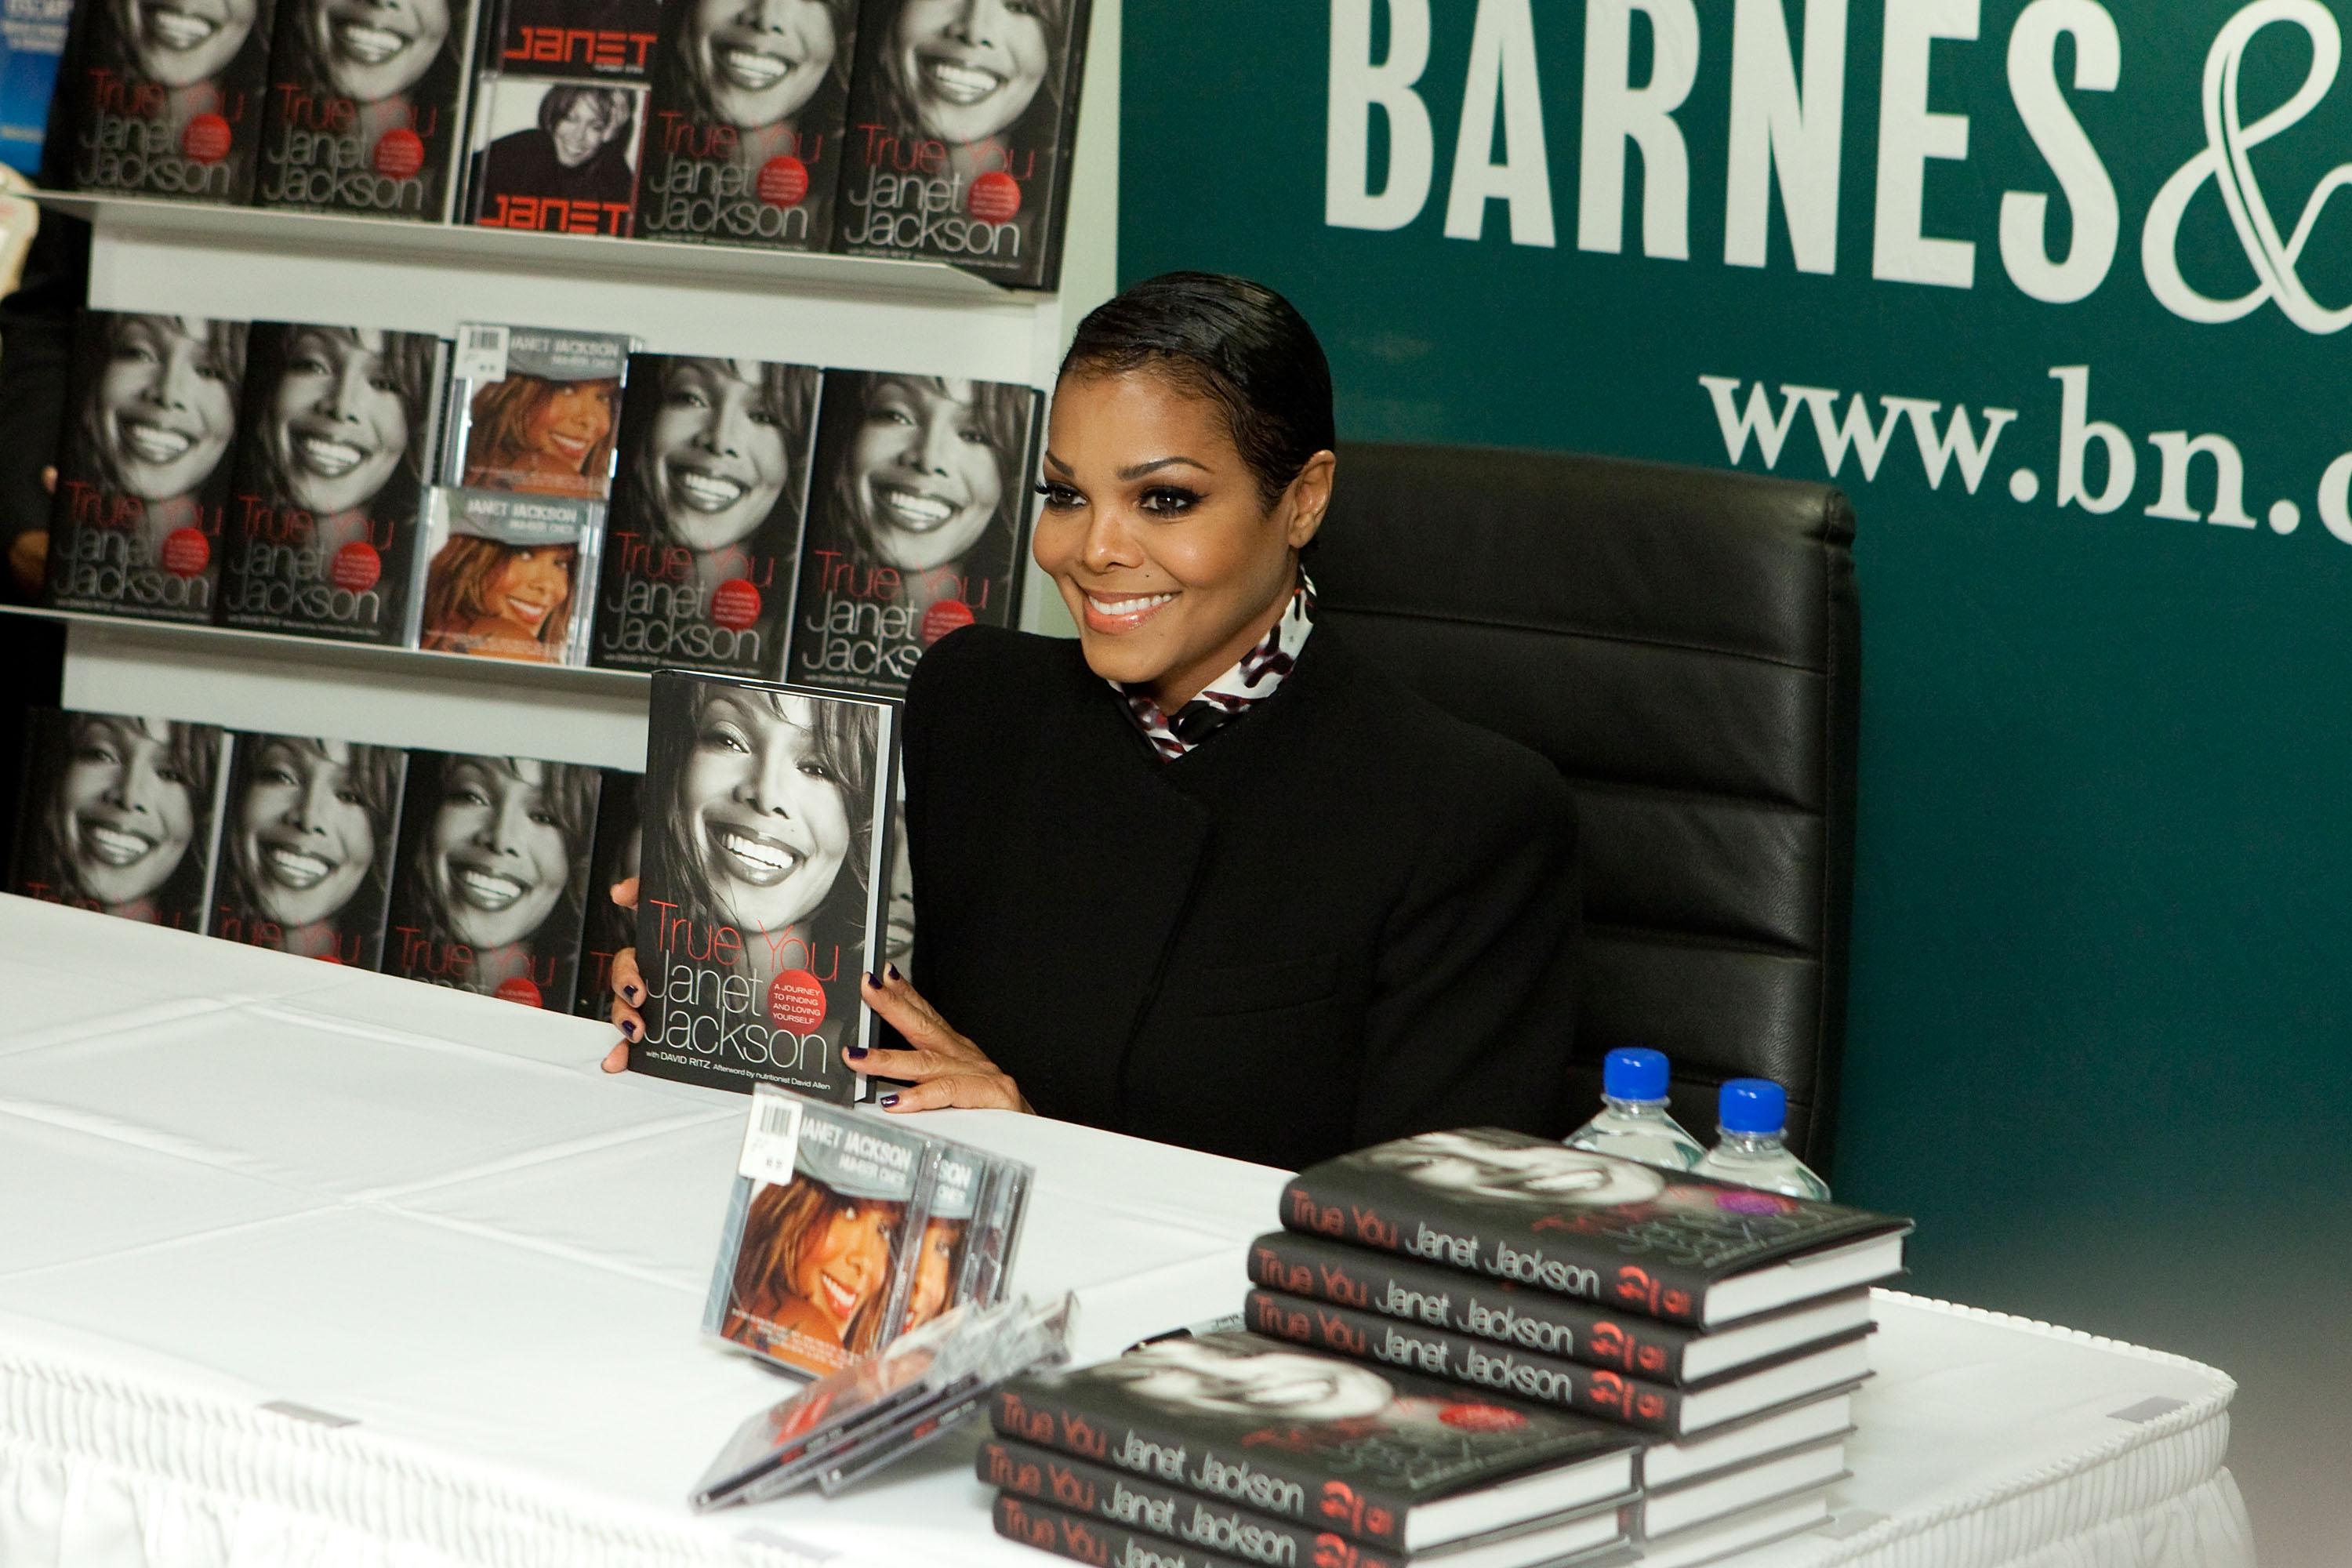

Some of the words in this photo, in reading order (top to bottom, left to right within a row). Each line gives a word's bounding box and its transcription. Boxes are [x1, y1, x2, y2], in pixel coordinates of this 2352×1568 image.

[858, 124, 947, 172] True
[263, 160, 423, 209] Jackson
[849, 164, 965, 213] Janet
[645, 191, 808, 238] Jackson
[844, 202, 1020, 257] Jackson
[615, 532, 693, 580] True
[815, 550, 901, 600] True
[224, 574, 379, 623] Jackson
[607, 572, 706, 619] Janet
[806, 590, 918, 641] Janet
[603, 612, 760, 662] Jackson
[802, 626, 922, 679] Jacks
[650, 899, 742, 966] True
[757, 919, 839, 982] You
[646, 949, 763, 1017] Janet
[782, 985, 820, 996] JOURNEY
[786, 995, 818, 1007] FINDING
[644, 995, 826, 1074] Jackson
[772, 1012, 815, 1025] YOURSELF
[773, 1003, 790, 1011] AND
[792, 1005, 821, 1016] LOVING
[645, 1051, 660, 1059] with
[660, 1051, 688, 1065] DAVID
[689, 1058, 712, 1070] RITZ
[713, 1063, 746, 1076] Afterword
[746, 1069, 755, 1079] by
[755, 1072, 790, 1084] nutritionist
[791, 1077, 811, 1087] David
[812, 1080, 831, 1091] Allen
[1289, 1189, 1345, 1236] True
[1352, 1204, 1398, 1250] You
[1405, 1221, 1479, 1269] Janet
[1484, 1240, 1600, 1299] Jackson
[1257, 1247, 1313, 1294] True
[1319, 1263, 1367, 1308] You
[1374, 1279, 1450, 1327] Janet
[1456, 1298, 1573, 1355] Jackson
[1254, 1295, 1312, 1342] True
[1318, 1309, 1366, 1356] You
[1374, 1326, 1450, 1375] Janet
[1454, 1345, 1572, 1403] Jackson
[1061, 1410, 1107, 1461] You
[1112, 1428, 1187, 1483] Janet
[1190, 1450, 1305, 1518] Jackson
[1047, 1462, 1094, 1512] You
[1101, 1480, 1175, 1536] Janet
